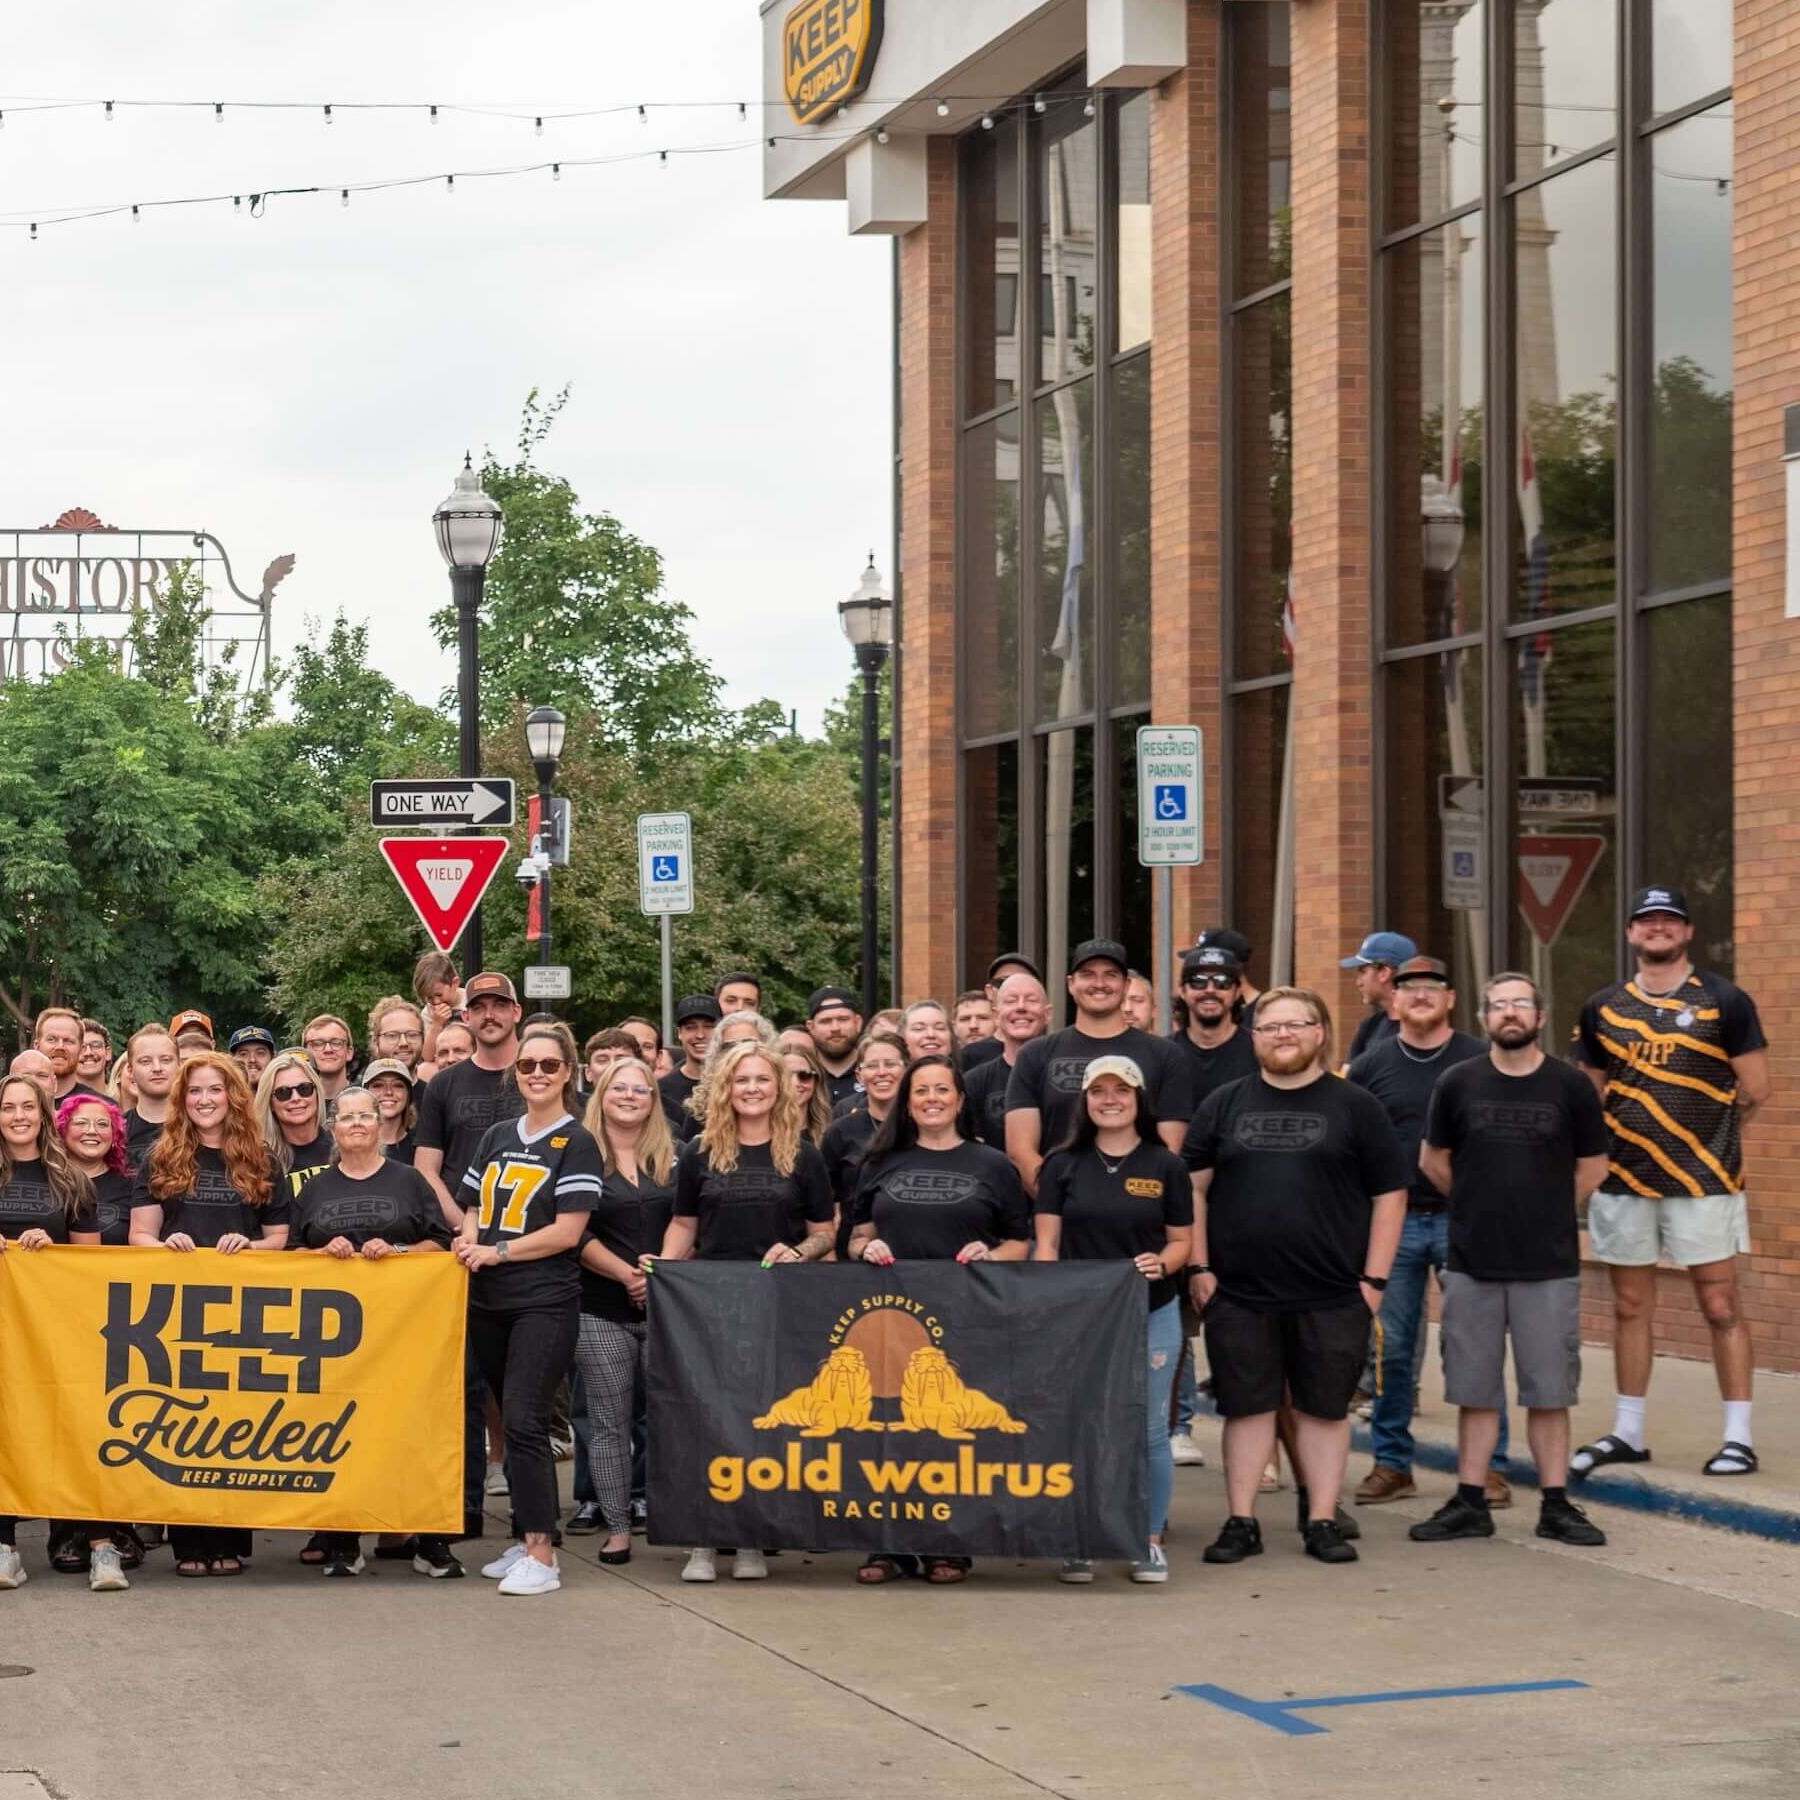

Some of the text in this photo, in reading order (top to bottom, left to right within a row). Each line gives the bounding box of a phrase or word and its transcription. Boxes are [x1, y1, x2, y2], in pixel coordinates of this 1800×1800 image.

[790, 0, 860, 76] KEEP
[801, 51, 849, 109] SUPPLY
[1143, 742, 1195, 756] RESERVED
[1147, 764, 1192, 777] PARKING
[387, 794, 469, 812] ONE WAY
[642, 824, 685, 836] RESERVED
[646, 840, 684, 851] PARKING
[426, 868, 463, 881] YIELD
[1241, 1118, 1321, 1133] KEEP
[895, 1176, 971, 1189] KEEP
[901, 1190, 957, 1200] SUPPLY
[321, 1202, 392, 1217] KEEP
[330, 1217, 380, 1230] SUPPLY
[829, 1295, 945, 1345] KEEP SUPPLY CO.
[99, 1282, 363, 1395] KEEP
[98, 1389, 358, 1468] Fueled
[181, 1470, 318, 1488] KEEP SUPPLY CO.
[708, 1442, 1074, 1504] gold walrus
[823, 1500, 953, 1521] RACING
